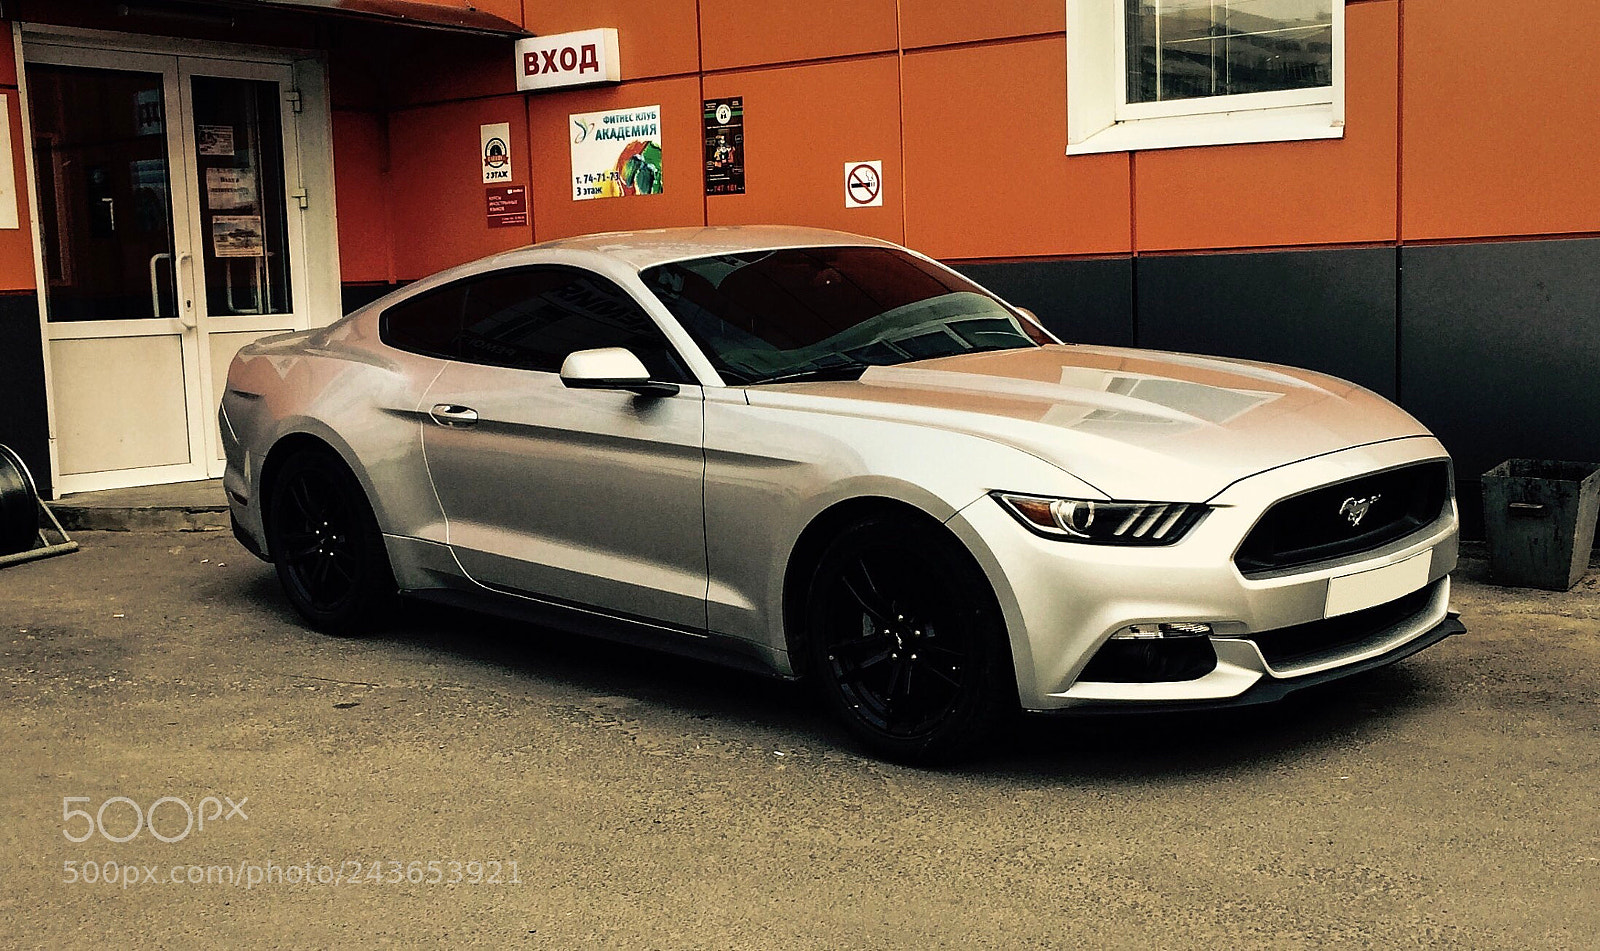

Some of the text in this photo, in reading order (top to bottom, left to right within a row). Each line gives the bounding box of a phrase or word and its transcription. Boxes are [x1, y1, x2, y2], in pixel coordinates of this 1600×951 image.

[523, 43, 599, 76] ВХОД
[602, 110, 657, 124] ФИТНЕС КЛУБ
[595, 123, 657, 141] АКАДЕМИЯ
[490, 170, 508, 179] ЭТАЖ
[583, 171, 620, 183] 74-71-73
[576, 186, 602, 196] 3 этаж
